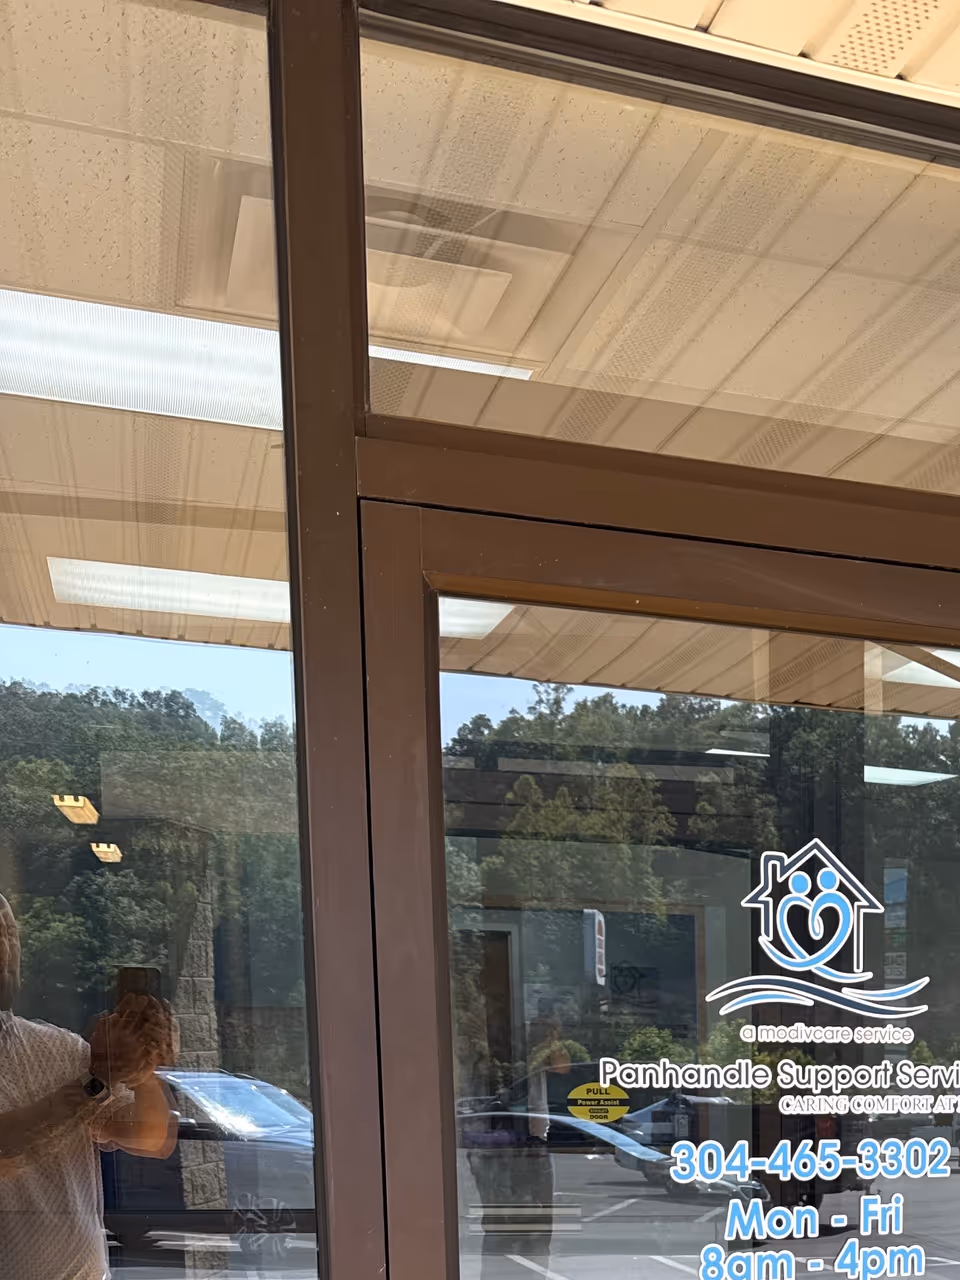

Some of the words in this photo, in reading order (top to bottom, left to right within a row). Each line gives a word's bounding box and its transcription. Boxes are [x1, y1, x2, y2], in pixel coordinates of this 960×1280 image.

[741, 1026, 755, 1041] a
[758, 1023, 851, 1042] modivcare
[854, 1025, 914, 1042] service
[601, 1058, 770, 1087] Panhandle
[778, 1060, 891, 1092] Support
[780, 1096, 848, 1113] CARING
[850, 1096, 933, 1113] COMFORT
[935, 1096, 957, 1113] AT
[671, 1139, 950, 1182] 304-465-3302
[726, 1199, 818, 1239] Mon
[831, 1214, 847, 1227] -
[860, 1194, 903, 1235] Fri
[807, 1257, 823, 1271] -
